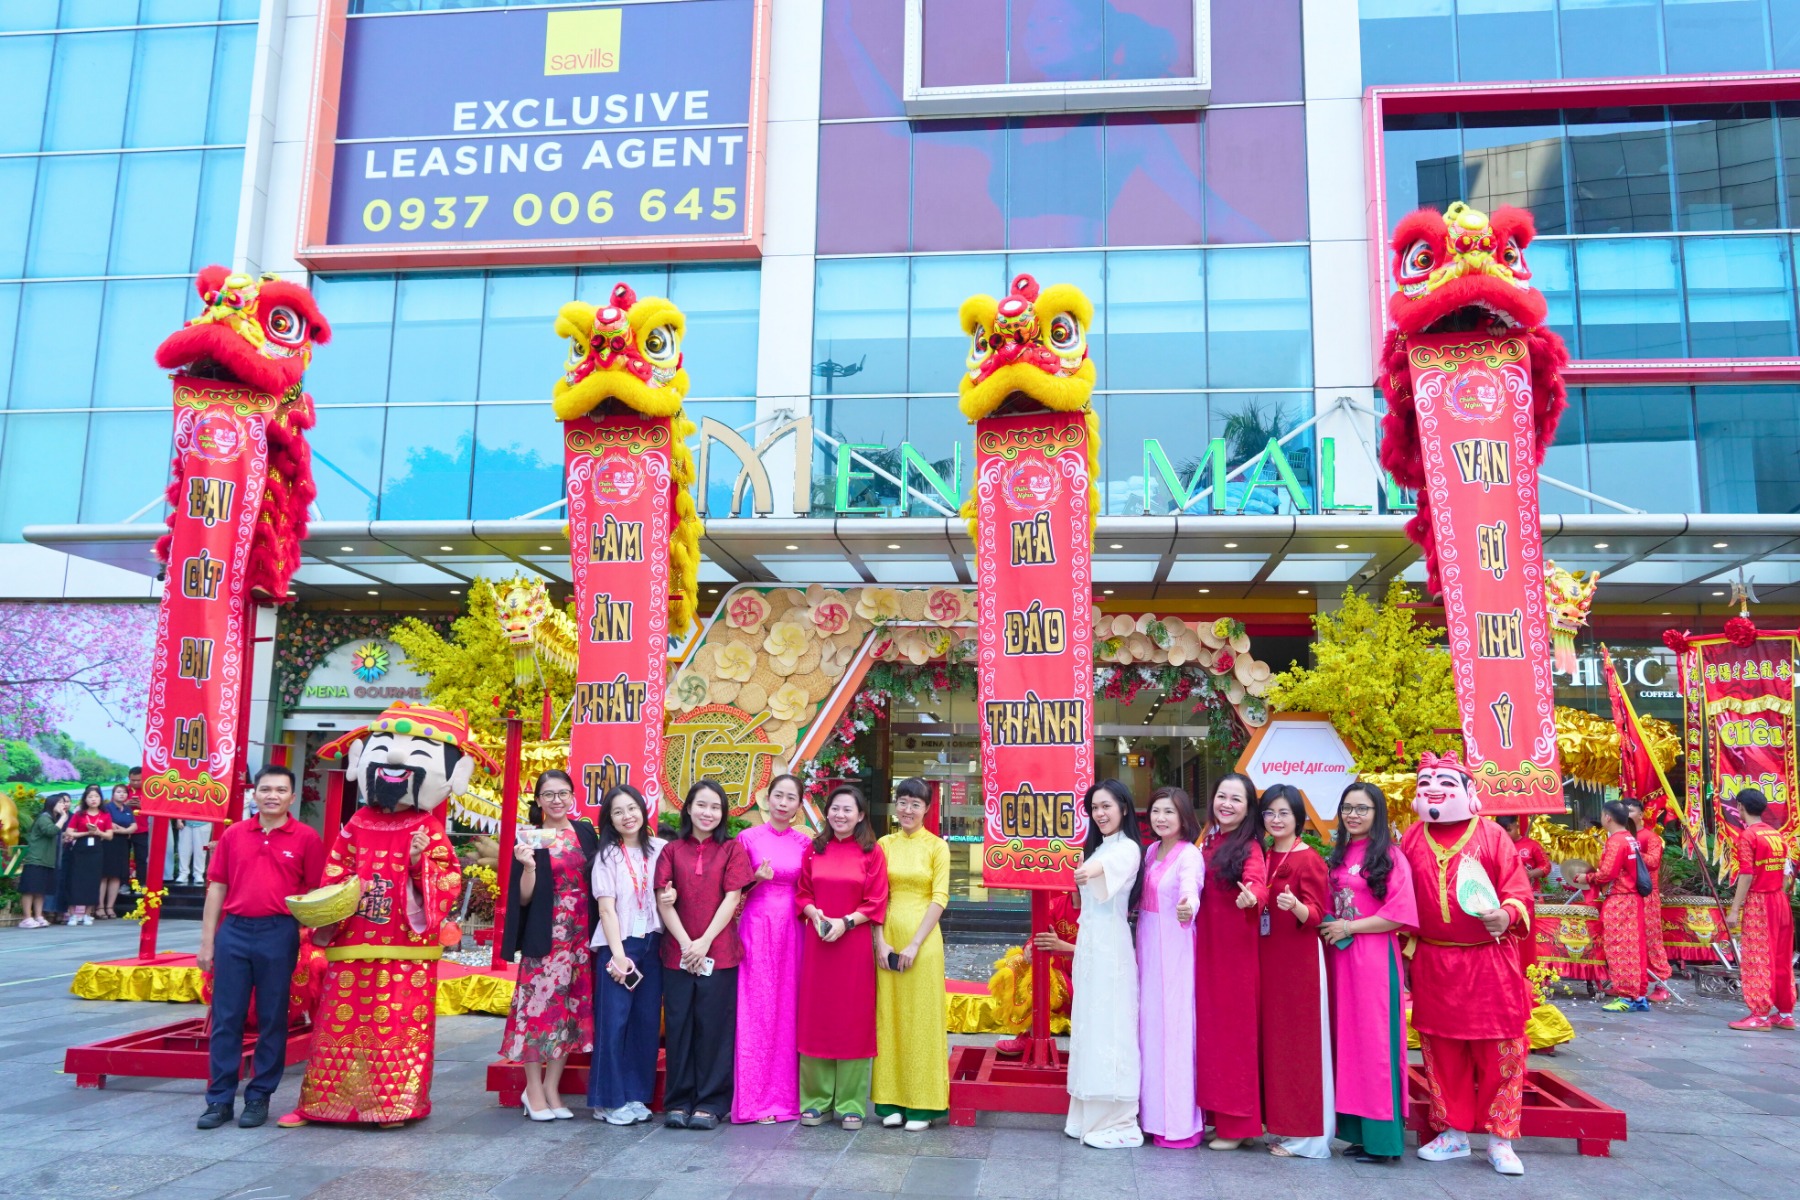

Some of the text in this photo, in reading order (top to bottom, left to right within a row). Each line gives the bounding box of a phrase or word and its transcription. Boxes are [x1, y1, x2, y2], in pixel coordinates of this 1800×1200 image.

[550, 48, 614, 71] savills
[453, 90, 709, 131] EXCLUSIVE
[365, 135, 743, 179] LEASING AGENT
[362, 187, 737, 232] 0937 006 645
[1452, 439, 1512, 492] VẠN
[188, 477, 234, 526] ĐẠI
[183, 549, 225, 599] CÁT
[1478, 521, 1509, 579] SỰ
[574, 514, 647, 805] LÀM ĂN PHÁT TÀI
[985, 511, 1086, 839] MÃ ĐÁO THÀNH CÔNG
[305, 686, 431, 700] MENA GOURME
[1640, 690, 1674, 698] COFFEE
[921, 740, 945, 748] MENA
[1491, 693, 1513, 748] Ý
[664, 711, 784, 808] TẾT
